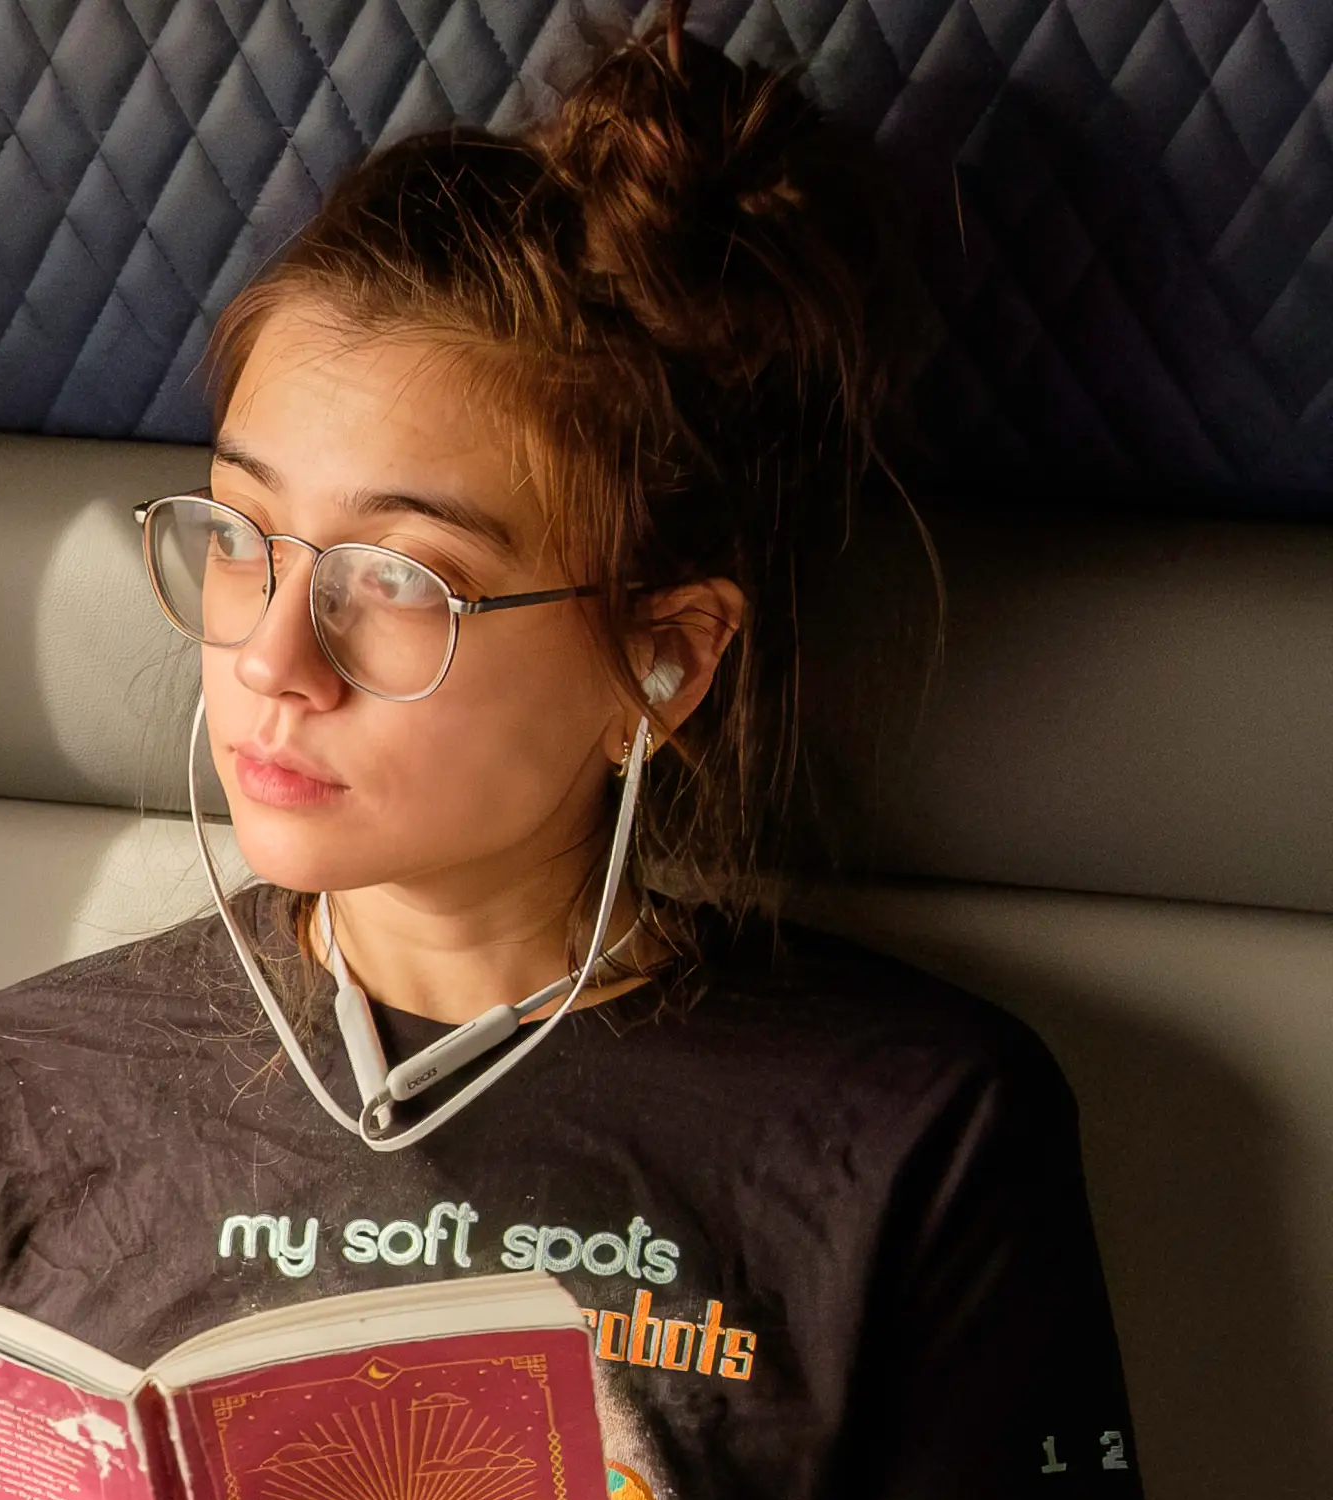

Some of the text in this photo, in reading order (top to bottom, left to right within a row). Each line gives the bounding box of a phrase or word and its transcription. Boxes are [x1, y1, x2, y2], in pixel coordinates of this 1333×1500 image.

[406, 1066, 439, 1091] beats
[218, 1200, 681, 1285] my soft spots
[1041, 1429, 1129, 1474] 1 2
